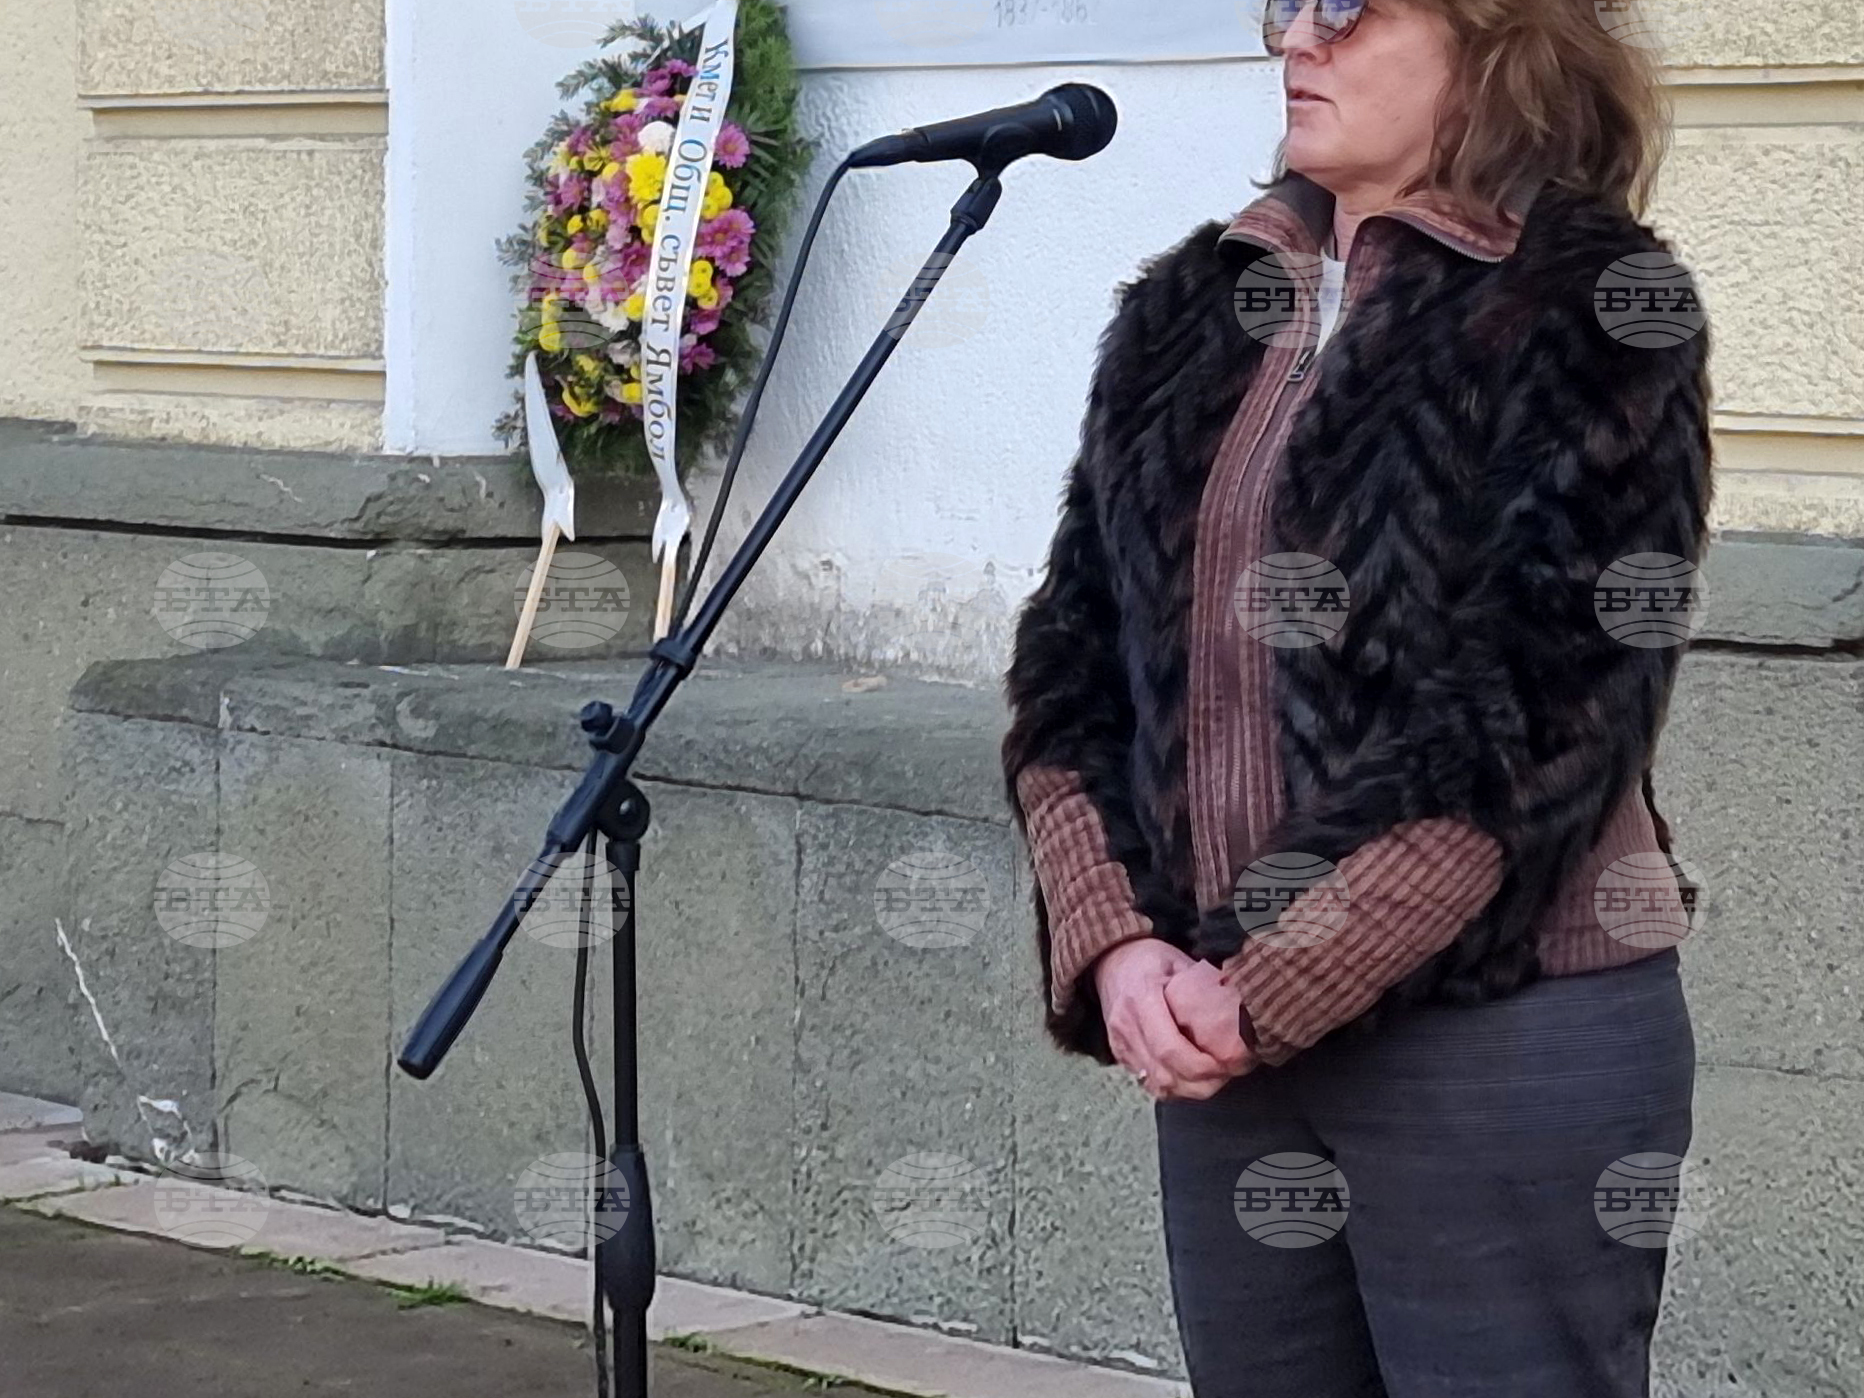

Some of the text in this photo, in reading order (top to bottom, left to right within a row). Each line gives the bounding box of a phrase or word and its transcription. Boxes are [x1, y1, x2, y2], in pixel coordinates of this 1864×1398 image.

[694, 38, 729, 102] Кмет
[661, 138, 708, 222] Общ.
[651, 233, 682, 333] съвет
[645, 342, 672, 461] Ямбол
